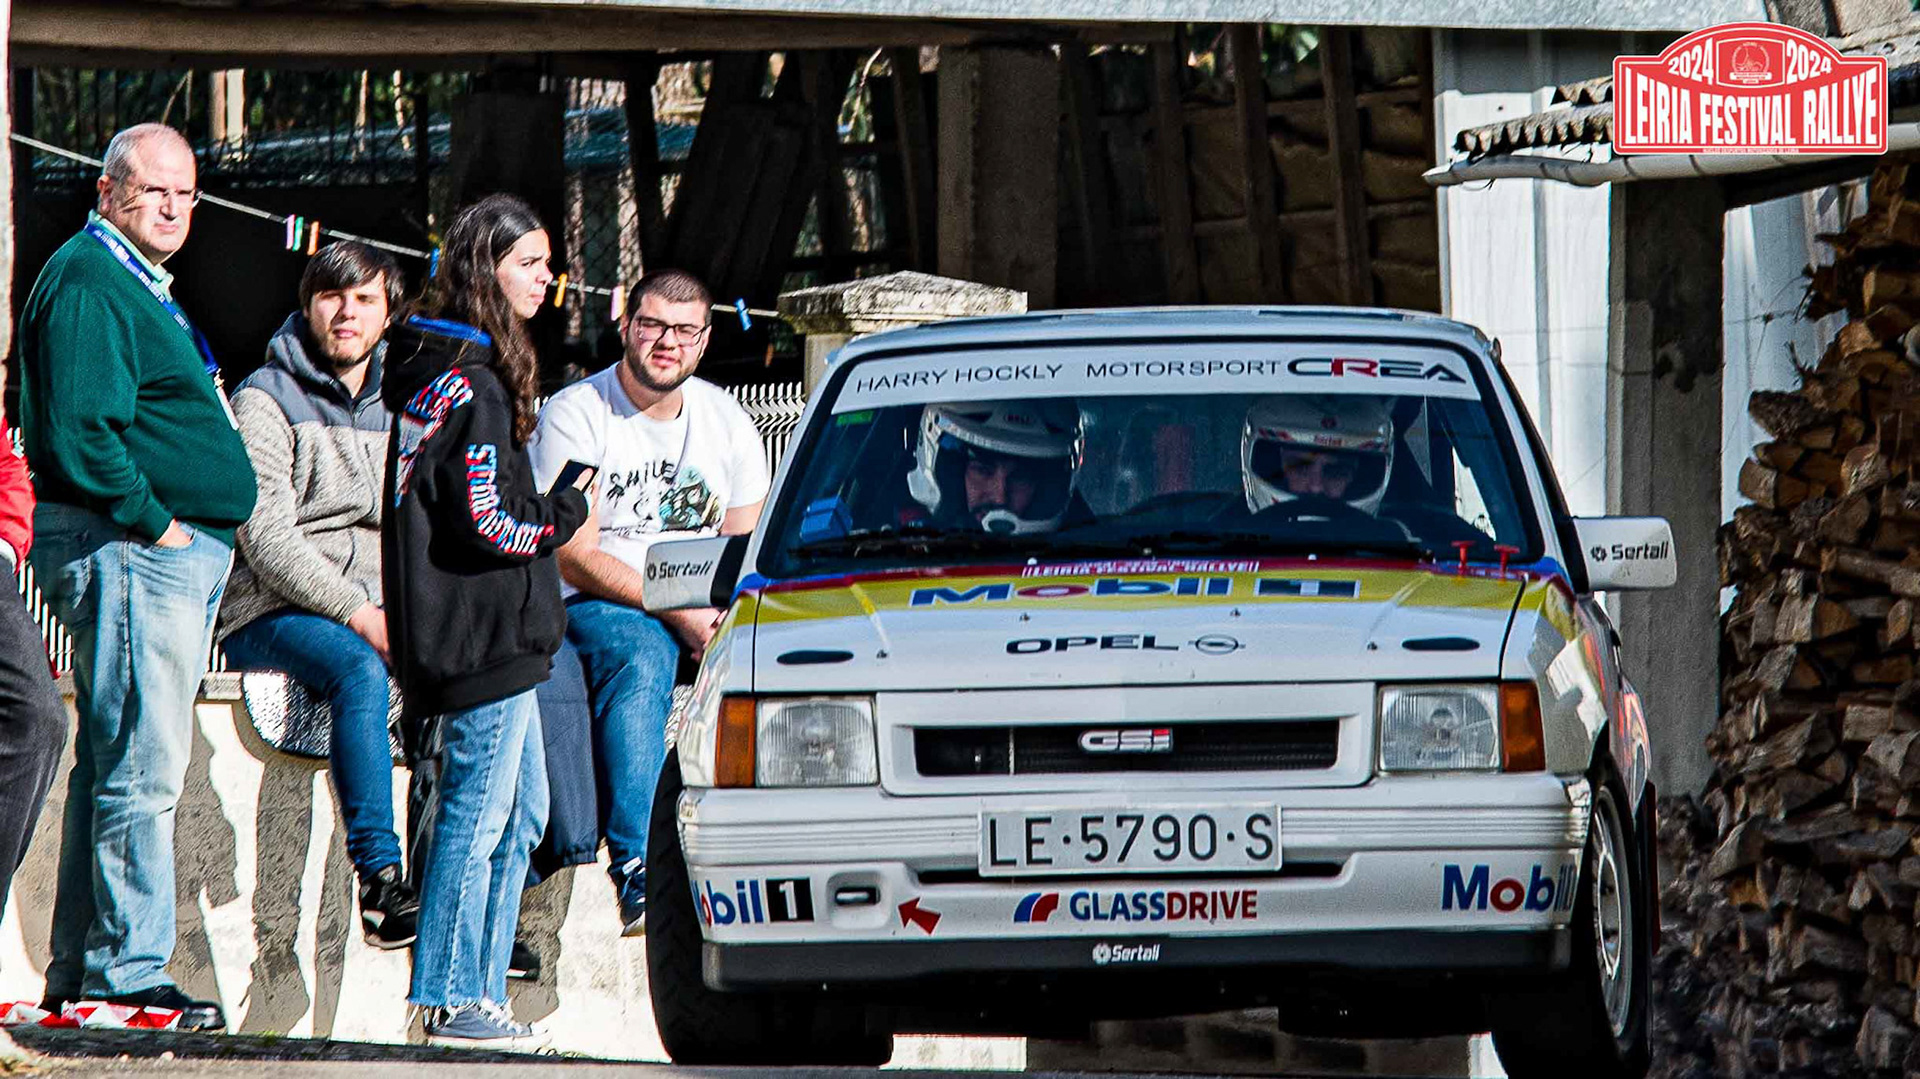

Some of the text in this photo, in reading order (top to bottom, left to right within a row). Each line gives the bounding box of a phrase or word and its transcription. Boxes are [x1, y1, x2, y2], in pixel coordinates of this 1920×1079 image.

[856, 359, 1281, 393] HARRY HOCKLY MOTORSPORT
[1287, 357, 1467, 385] CREA
[1006, 634, 1179, 654] OPEL
[1069, 890, 1258, 921] GLASSDRIVE
